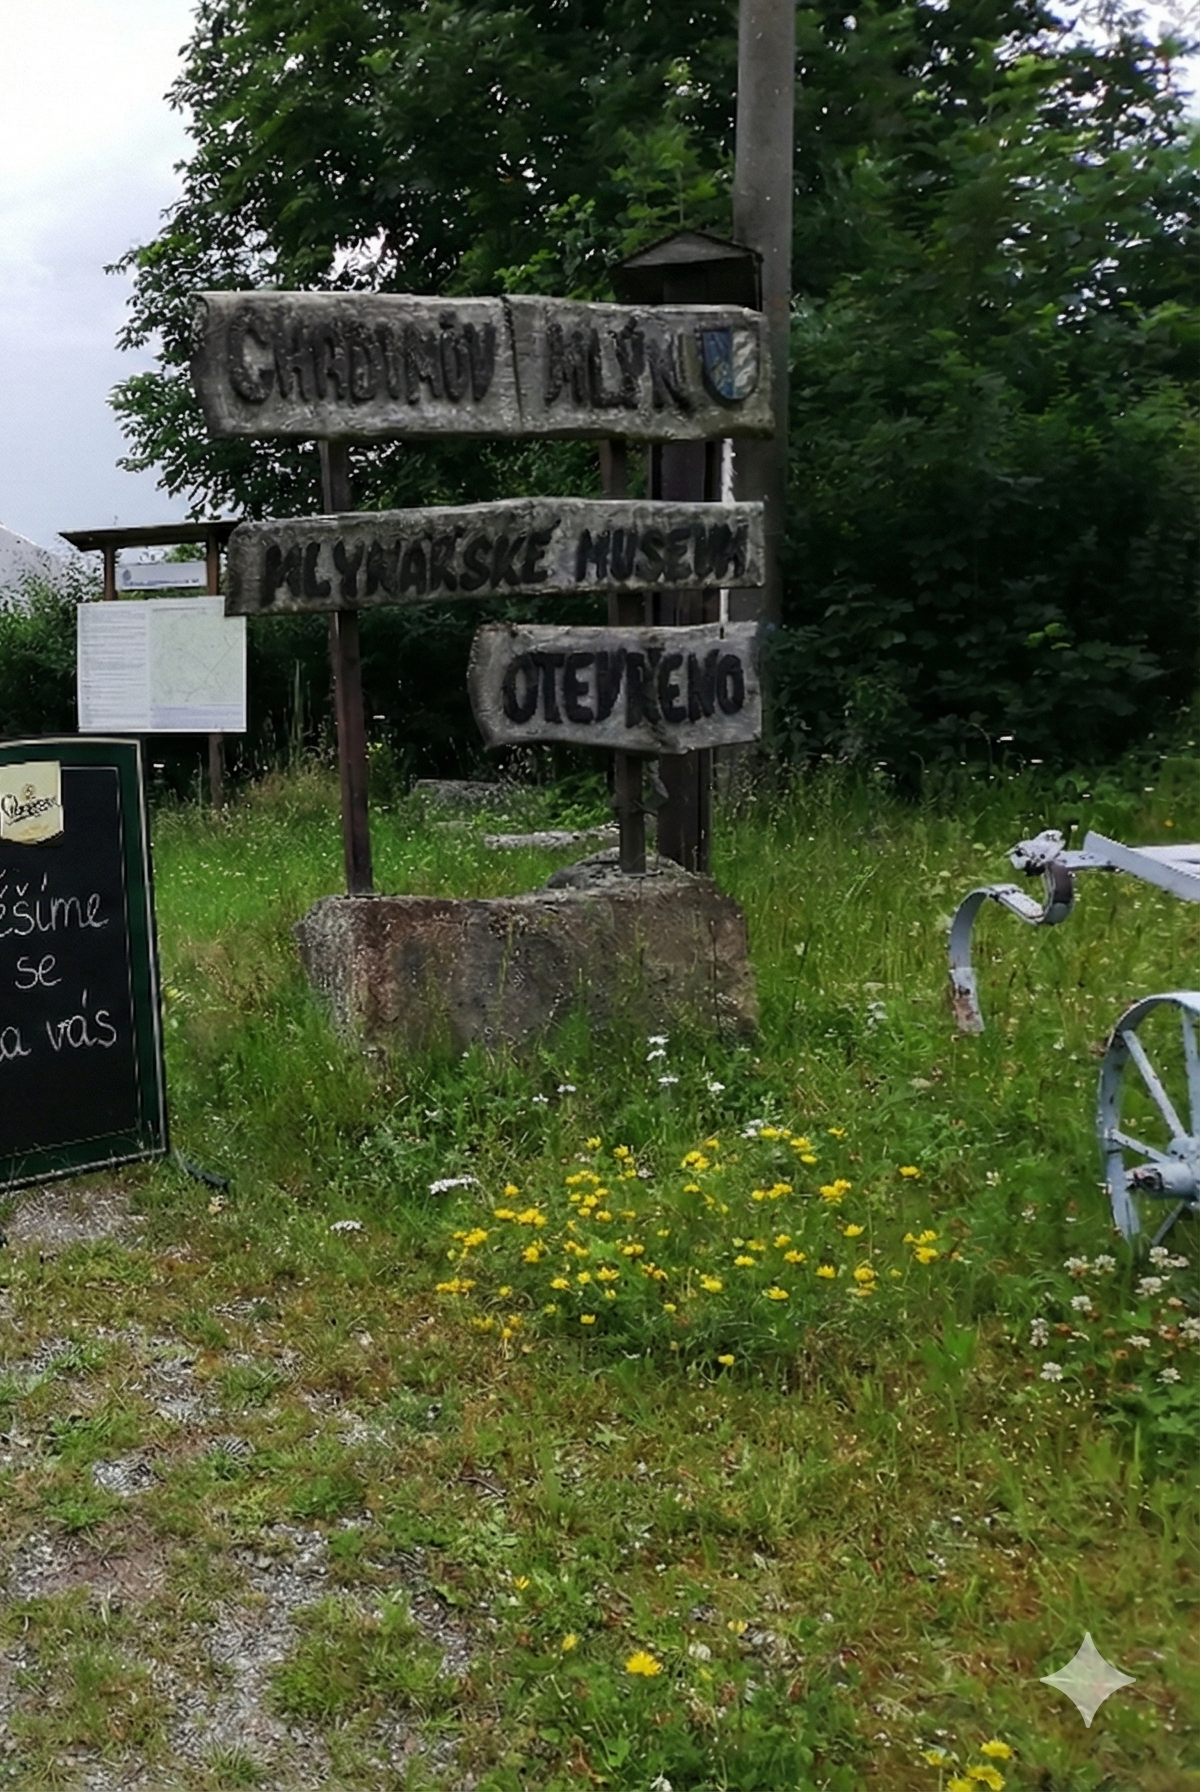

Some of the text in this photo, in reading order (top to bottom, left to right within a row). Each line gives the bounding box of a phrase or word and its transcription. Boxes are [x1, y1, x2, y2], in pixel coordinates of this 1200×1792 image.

[576, 523, 749, 582] MUSEUM
[502, 648, 744, 727] OTEVŘENO
[14, 953, 62, 989] se
[45, 989, 118, 1052] vás
